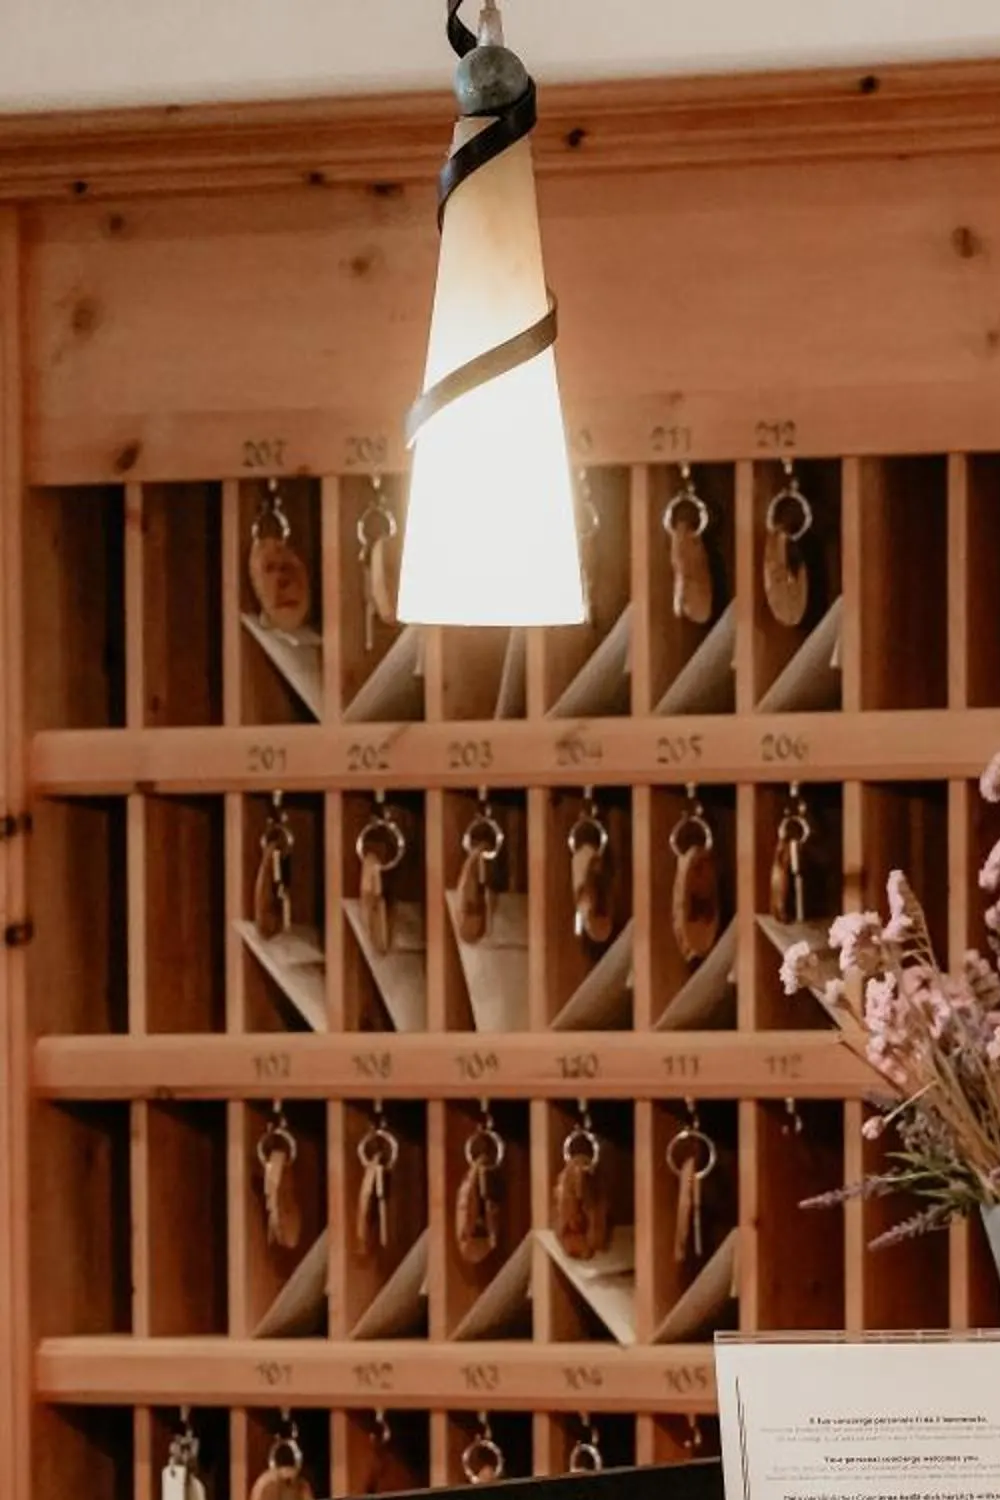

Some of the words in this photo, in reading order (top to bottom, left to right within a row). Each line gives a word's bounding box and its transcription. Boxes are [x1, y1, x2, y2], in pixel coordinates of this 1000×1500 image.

[240, 439, 288, 467] 207
[649, 425, 692, 453] 211
[755, 420, 797, 448] 212
[246, 745, 287, 773] 201
[347, 744, 390, 771] 202
[448, 740, 493, 769] 203
[657, 736, 703, 763] 205
[760, 733, 809, 762] 206
[454, 1052, 500, 1080] 109
[661, 1055, 701, 1077] 111
[764, 1053, 802, 1079] 112
